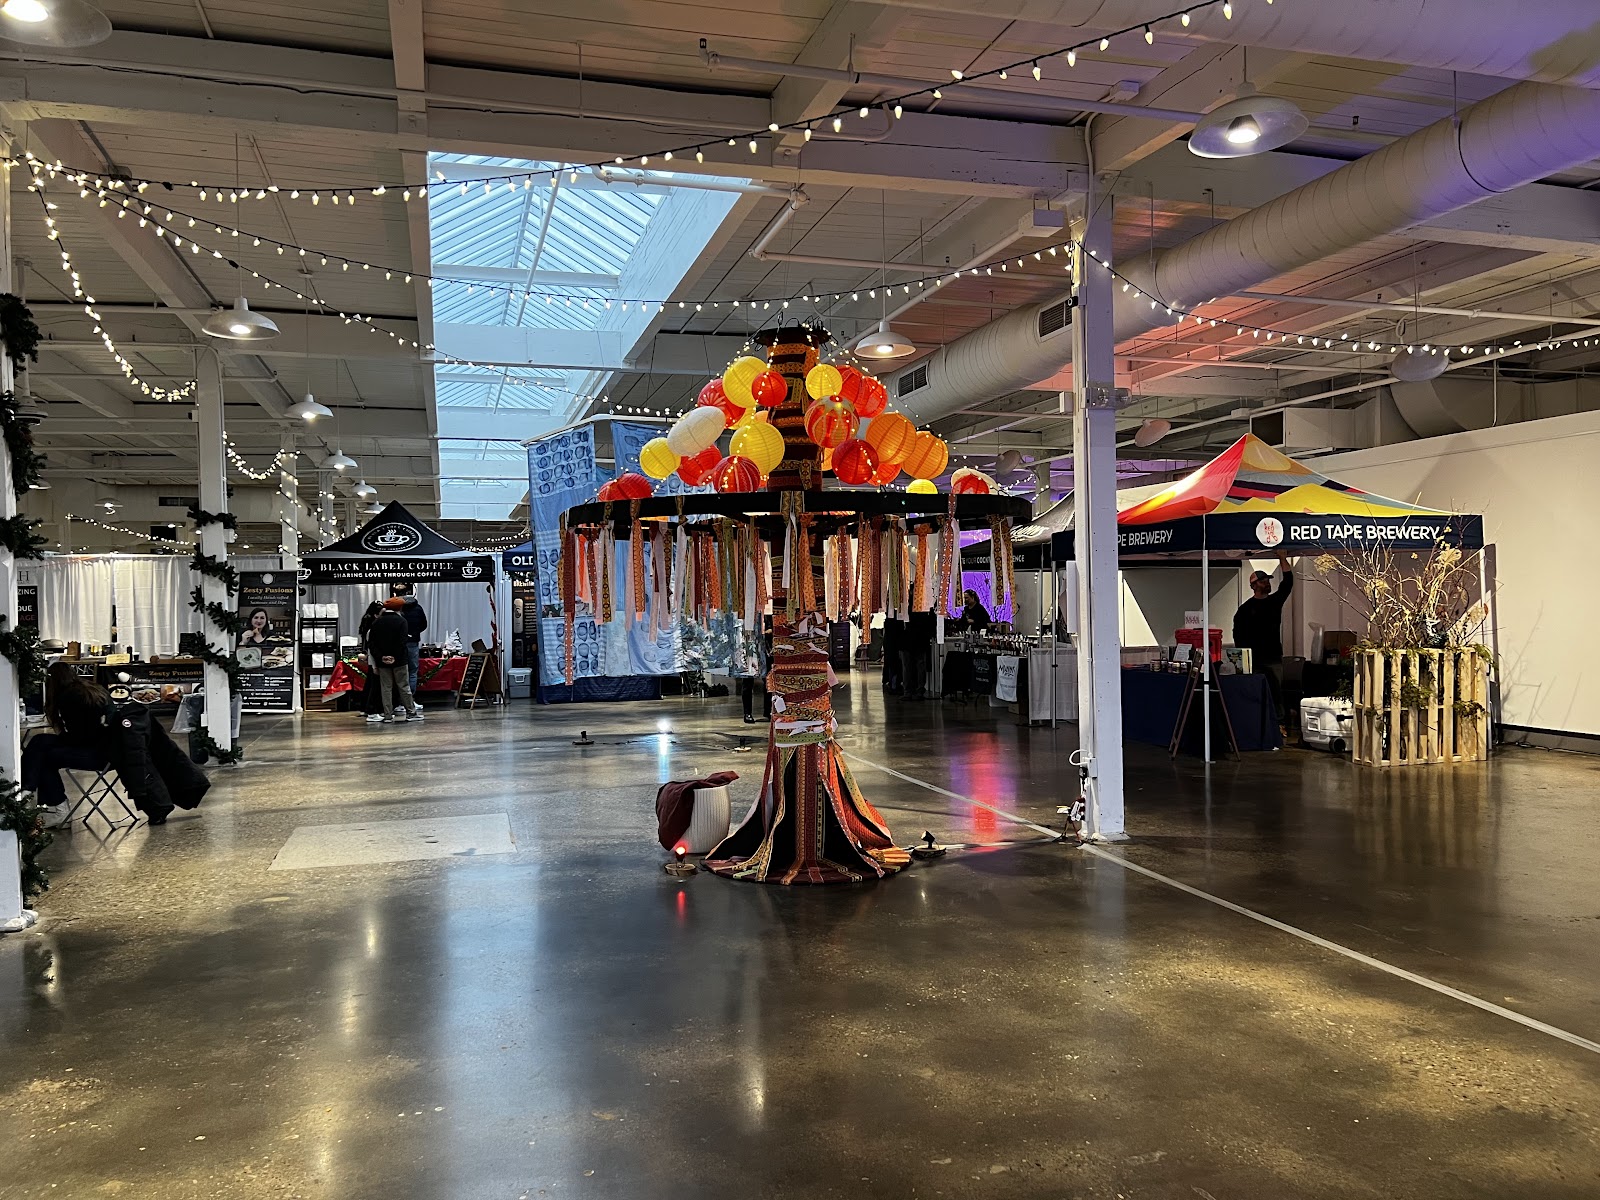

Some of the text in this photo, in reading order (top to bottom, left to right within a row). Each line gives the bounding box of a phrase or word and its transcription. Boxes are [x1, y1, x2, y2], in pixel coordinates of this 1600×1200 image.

[1117, 529, 1173, 546] PE BREWERY
[1290, 525, 1440, 540] RED TAPE BREWERY
[320, 561, 454, 572] BLACK LABEL COFFEE
[243, 586, 263, 595] Zesty
